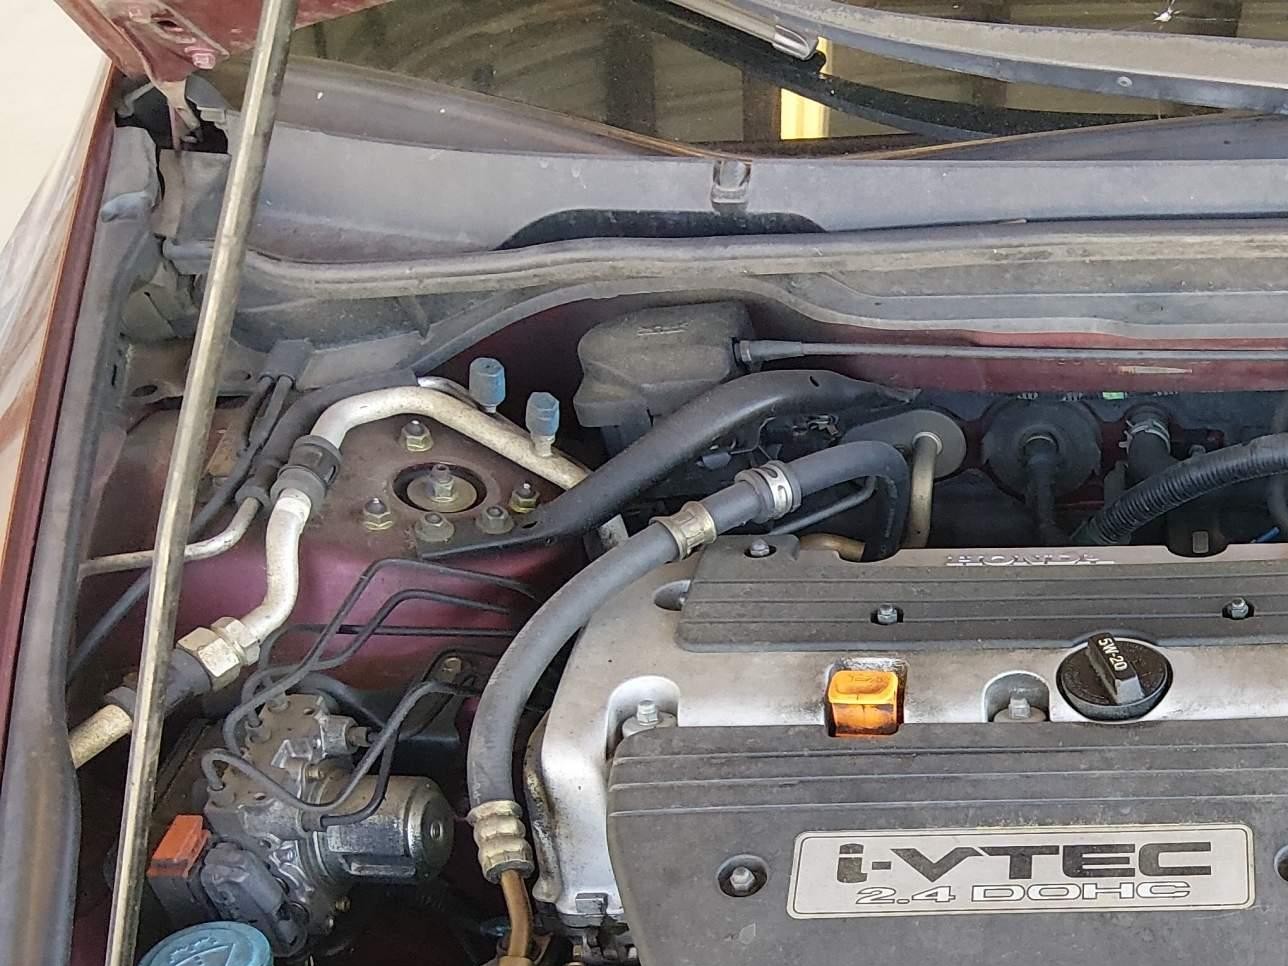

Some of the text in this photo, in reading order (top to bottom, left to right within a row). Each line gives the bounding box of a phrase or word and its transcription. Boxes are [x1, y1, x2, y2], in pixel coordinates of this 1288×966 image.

[1098, 637, 1128, 672] 5W-20
[836, 841, 1212, 884] i-VTEC
[855, 881, 1192, 906] 2.4 DOHC
